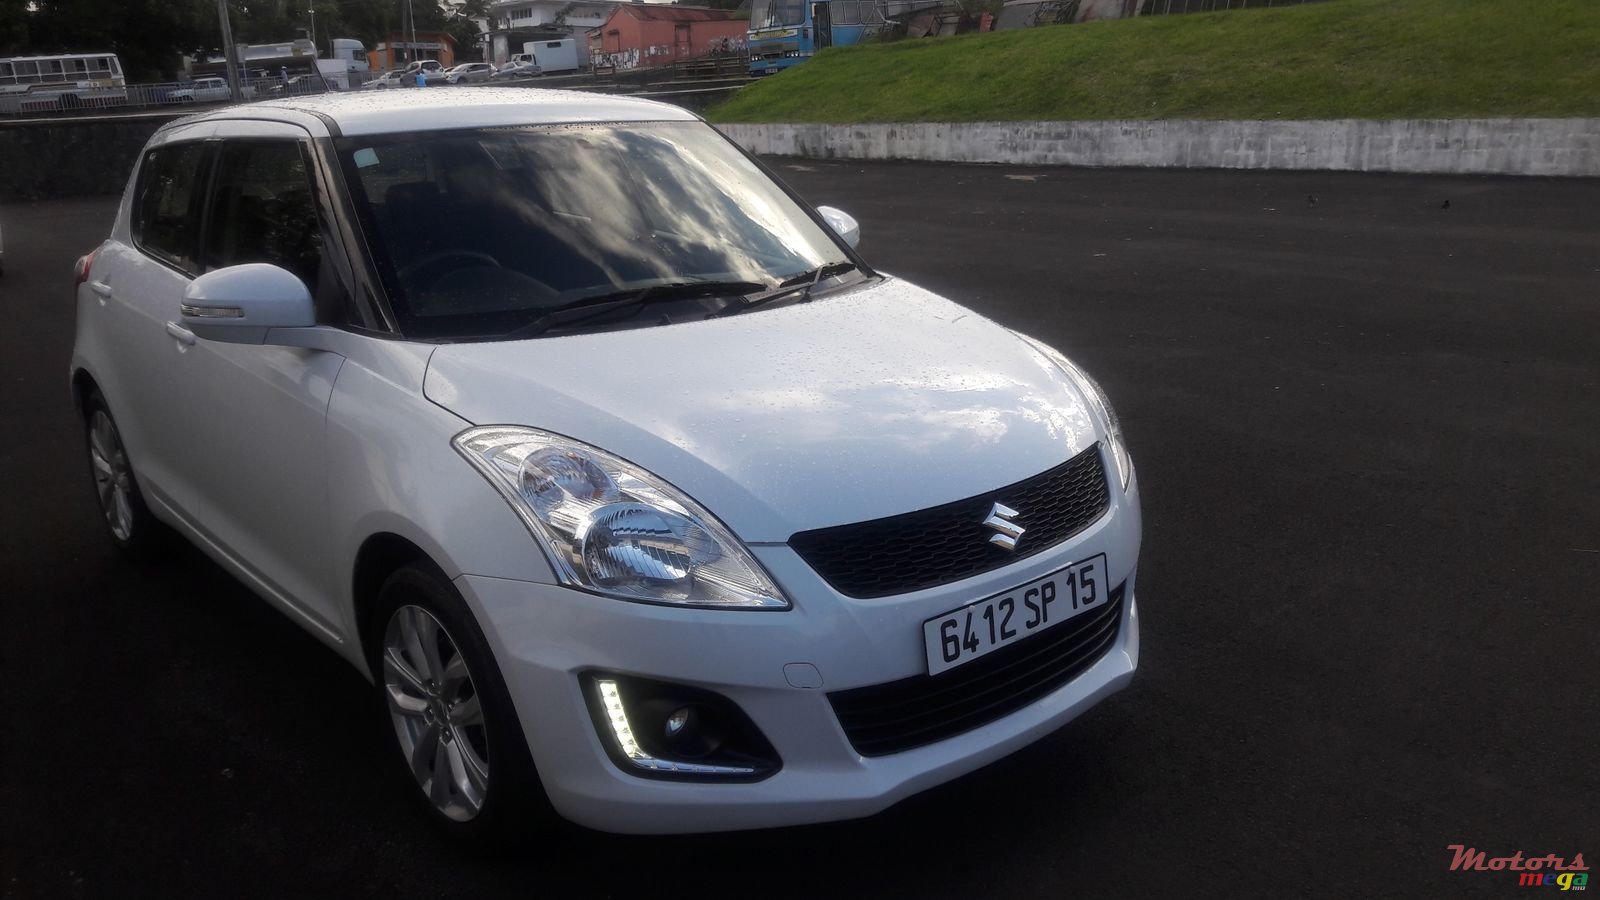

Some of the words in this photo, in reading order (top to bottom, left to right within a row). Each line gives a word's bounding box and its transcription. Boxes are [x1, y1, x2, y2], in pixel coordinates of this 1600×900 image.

[941, 598, 1016, 663] 6412
[1024, 581, 1056, 629] SP
[1066, 565, 1096, 609] 15
